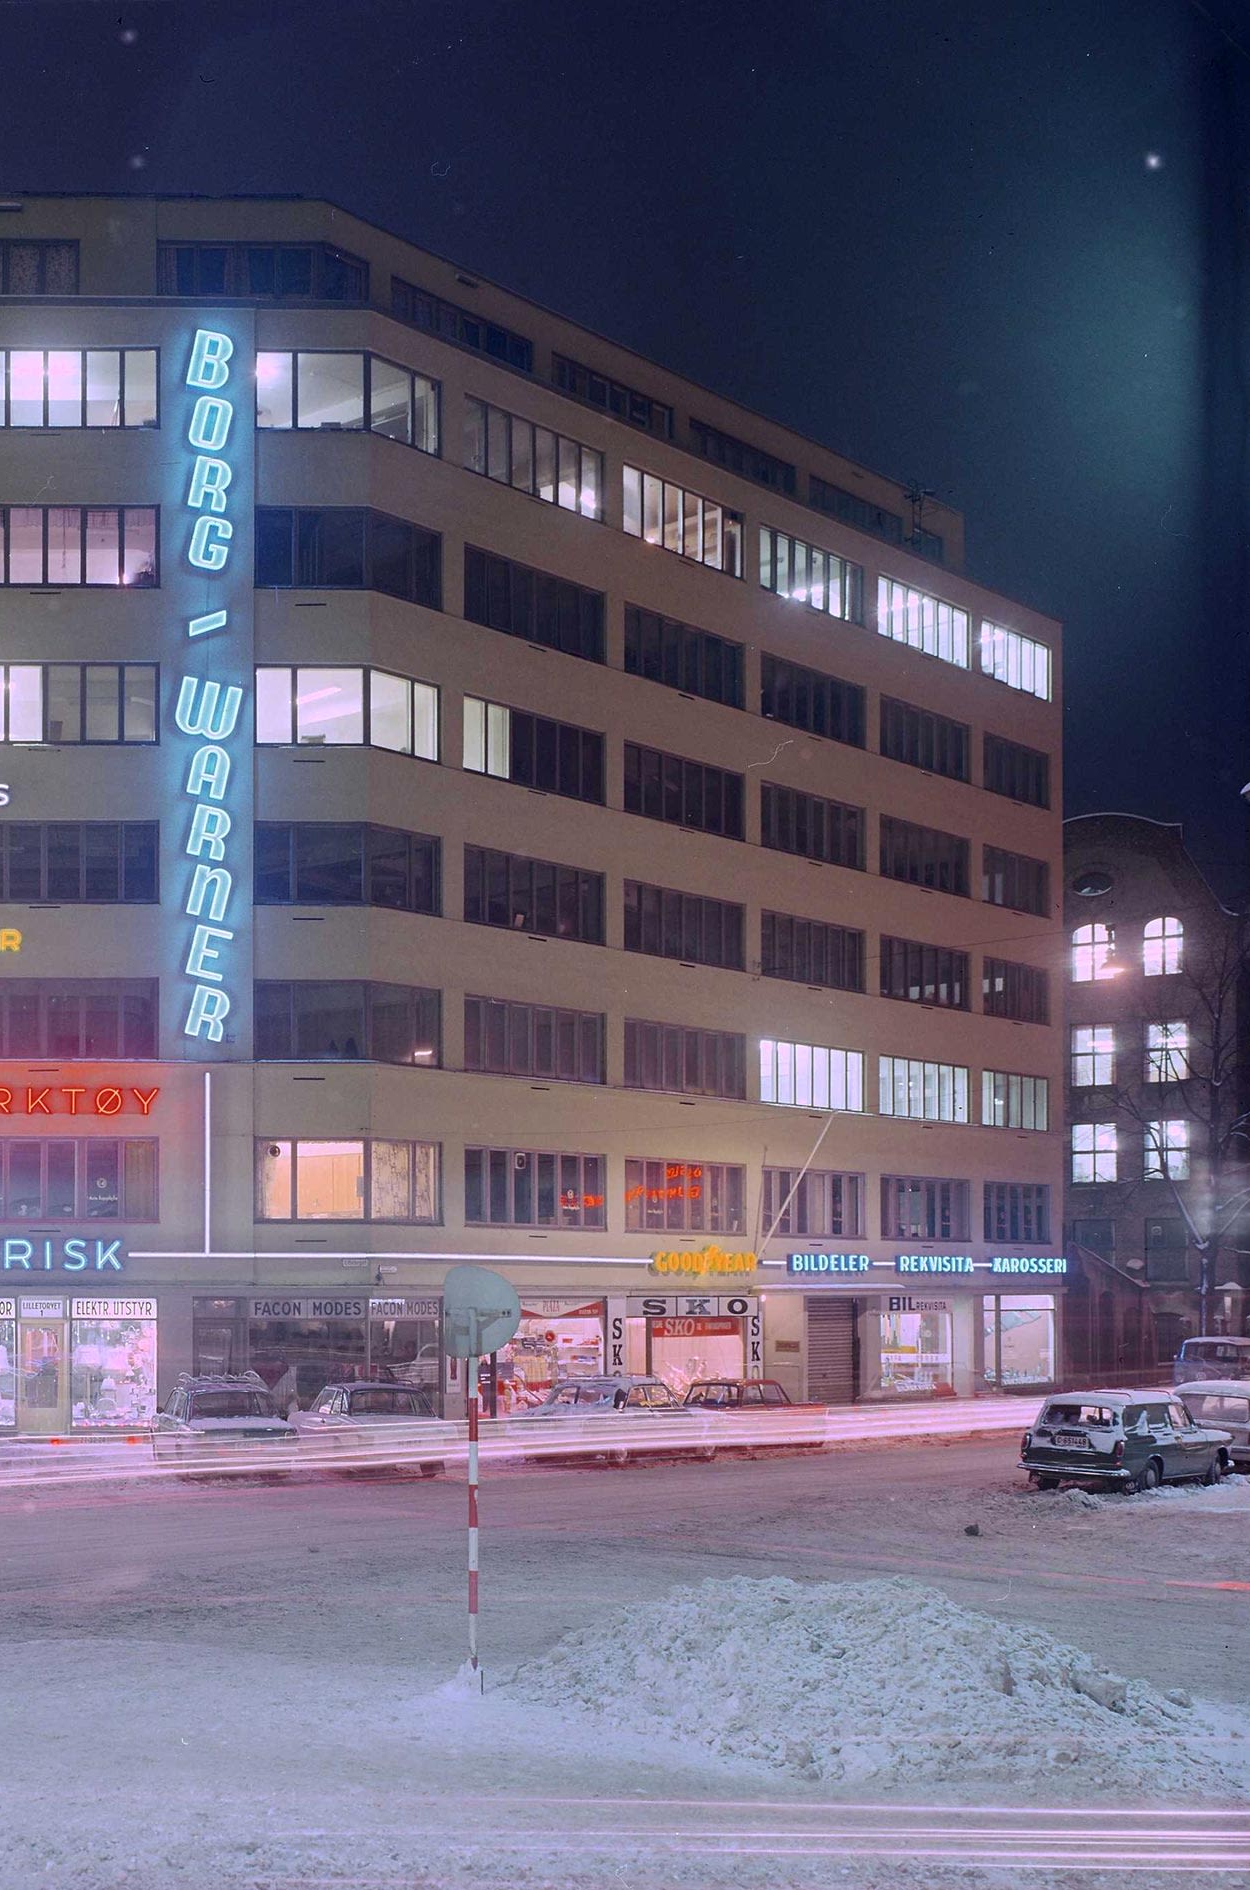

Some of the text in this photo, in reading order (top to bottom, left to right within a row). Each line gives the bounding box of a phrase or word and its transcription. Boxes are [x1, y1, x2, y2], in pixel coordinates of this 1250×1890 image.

[186, 329, 234, 571] BORG
[175, 675, 243, 1043] WARNER
[792, 1254, 1067, 1274] BILDELER REKVISITA KAROSSERI
[113, 1301, 153, 1316] UTSTYR
[254, 1302, 362, 1316] FACON MODES
[370, 1300, 439, 1316] FACON MODES
[641, 1298, 749, 1316] SKO
[664, 1318, 696, 1336] SKO
[612, 1317, 623, 1376] SK
